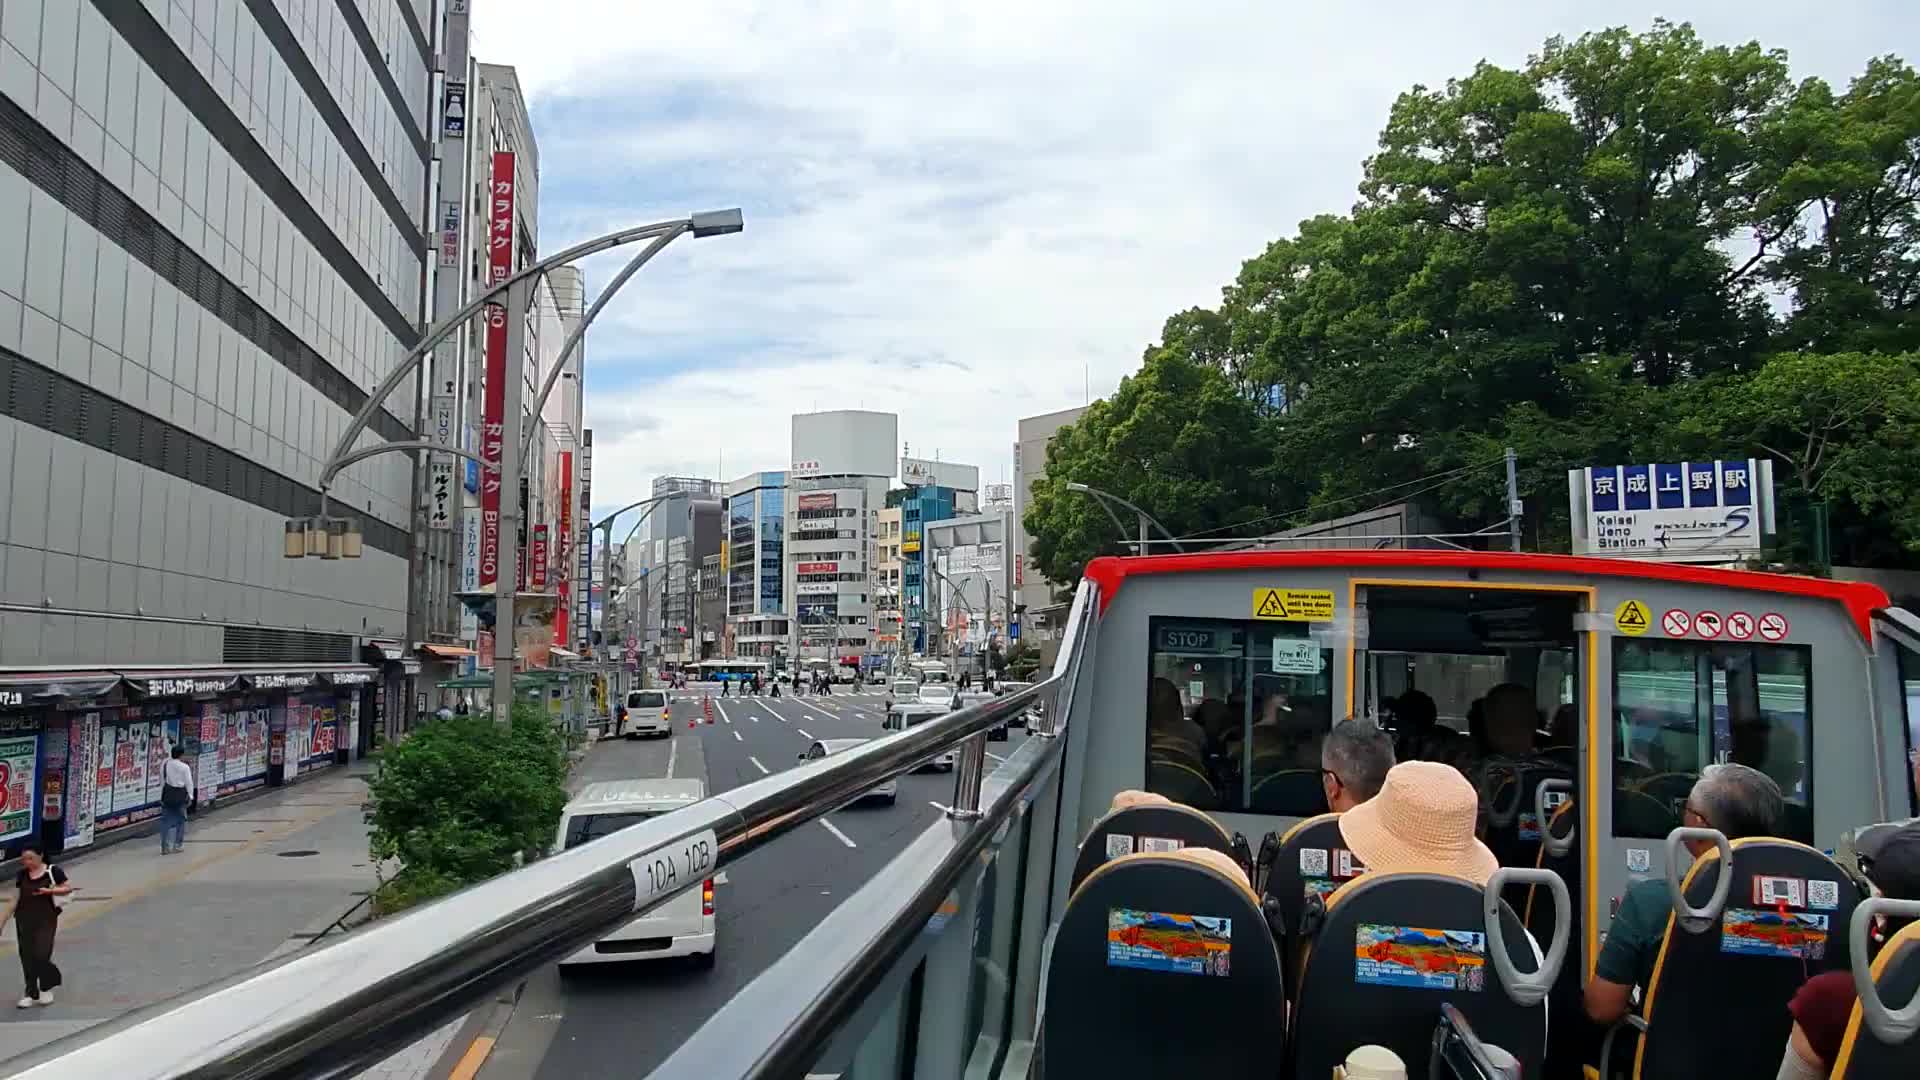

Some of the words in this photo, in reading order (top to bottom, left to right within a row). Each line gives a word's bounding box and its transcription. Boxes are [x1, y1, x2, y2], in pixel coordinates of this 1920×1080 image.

[494, 181, 511, 249] カラオケ
[484, 423, 503, 494] カラオケ
[1593, 468, 1747, 496] 京成上野駅
[432, 474, 449, 521] ルノアール
[1597, 515, 1637, 526] Keisei
[1597, 526, 1631, 537] Ueno
[1654, 519, 1728, 530] SKYLINER
[1598, 536, 1646, 548] Station
[1167, 631, 1209, 647] STOP
[647, 856, 677, 895] 10A
[684, 840, 710, 877] 10B
